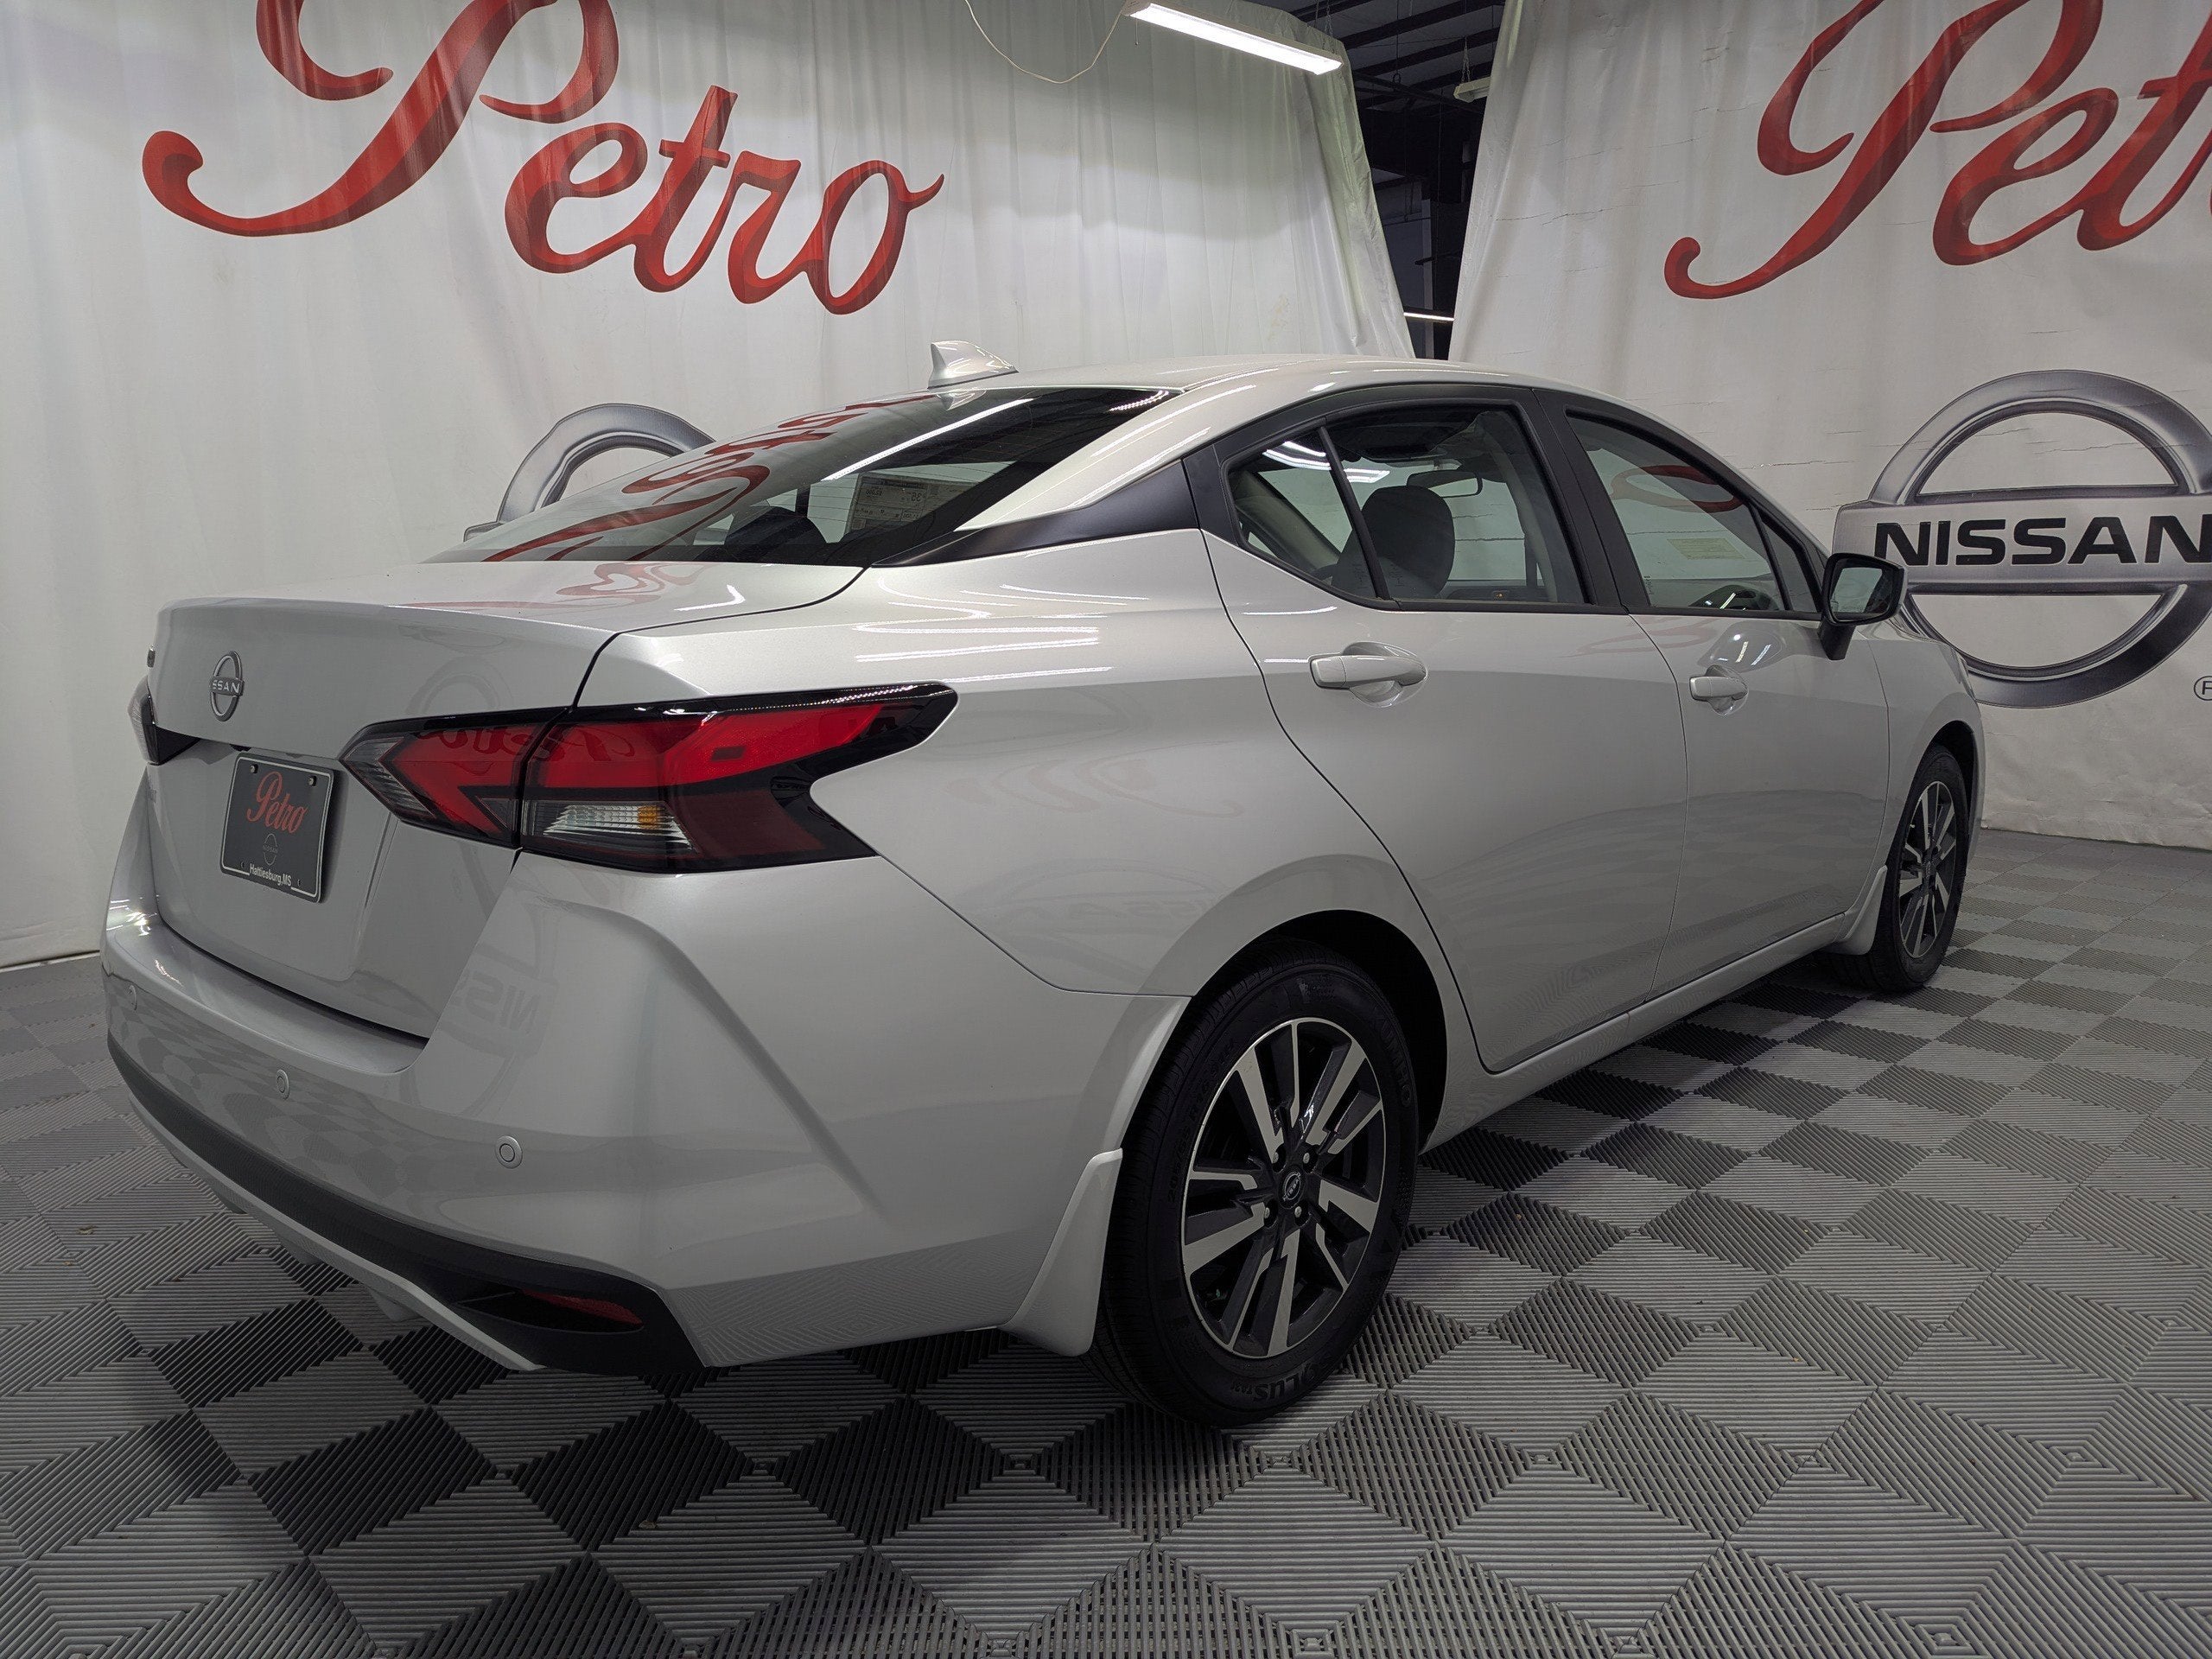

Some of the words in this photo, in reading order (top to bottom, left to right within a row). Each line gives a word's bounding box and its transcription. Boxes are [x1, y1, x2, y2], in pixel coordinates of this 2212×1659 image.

[143, 0, 945, 315] Petro
[1664, 0, 2212, 299] Pet
[1874, 513, 2212, 566] NISSAN
[246, 771, 308, 834] Petro
